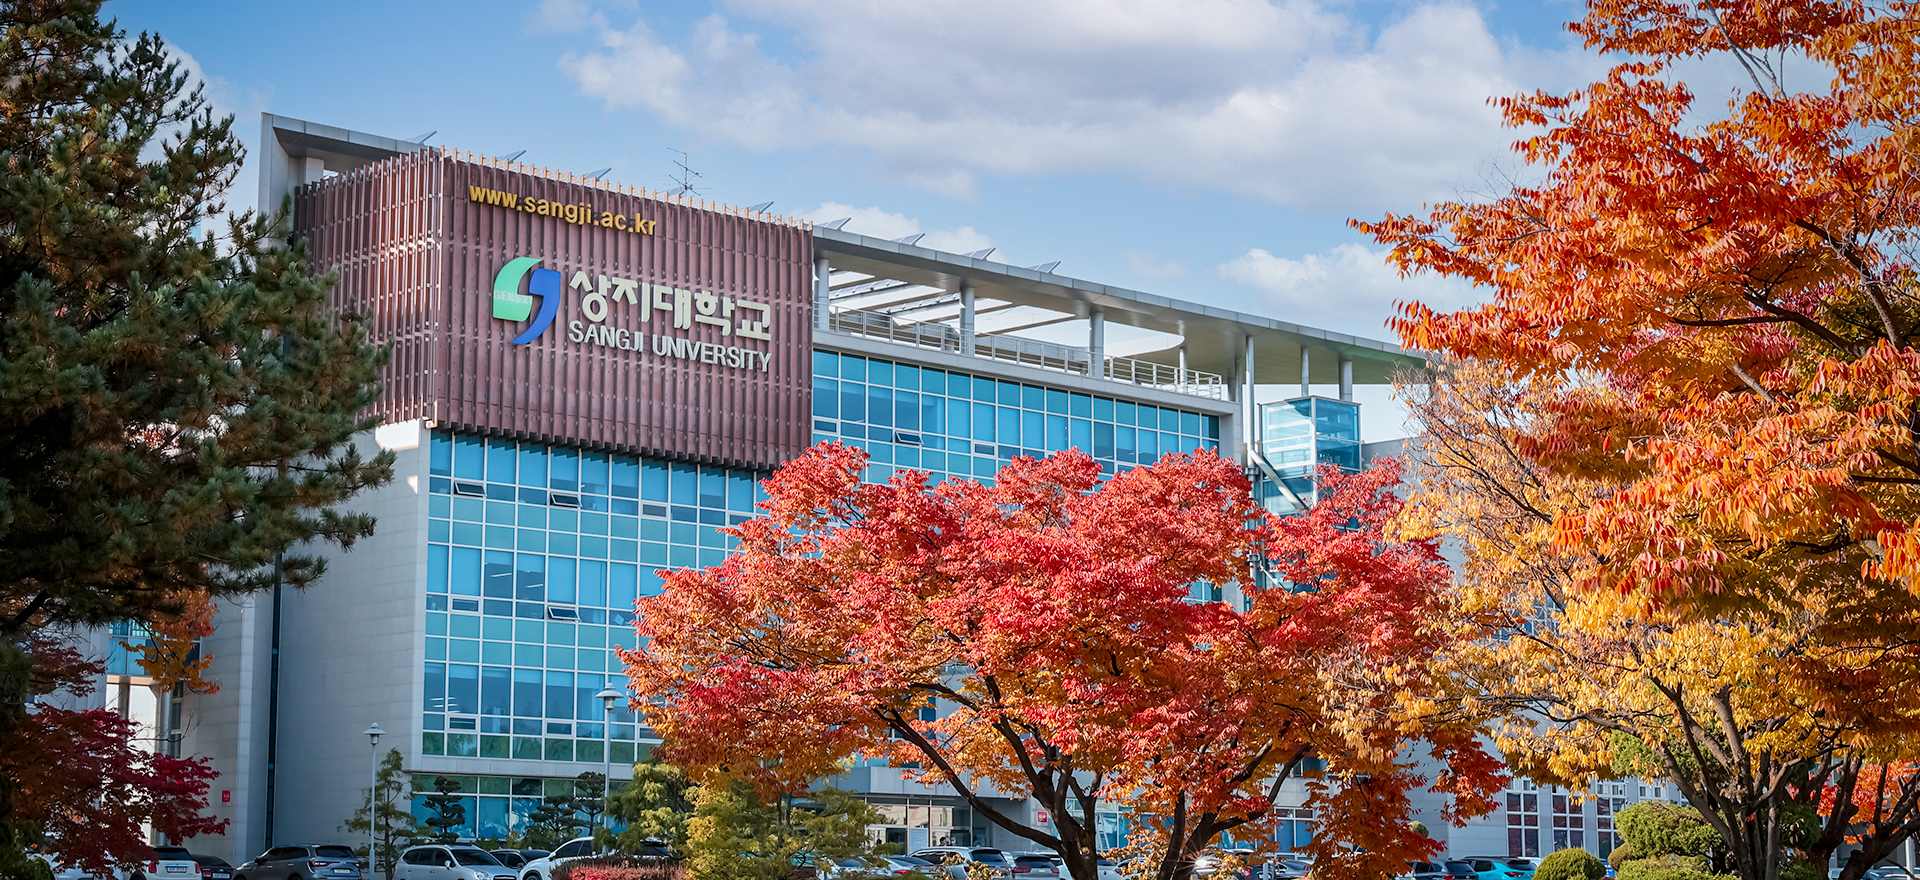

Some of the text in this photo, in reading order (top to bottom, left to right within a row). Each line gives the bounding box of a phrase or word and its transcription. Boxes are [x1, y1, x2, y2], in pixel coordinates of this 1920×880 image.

[469, 185, 656, 235] www.sangji.ac.kr
[569, 271, 771, 341] 상지대학교
[569, 320, 772, 372] SANGJI UNIVERSITY
